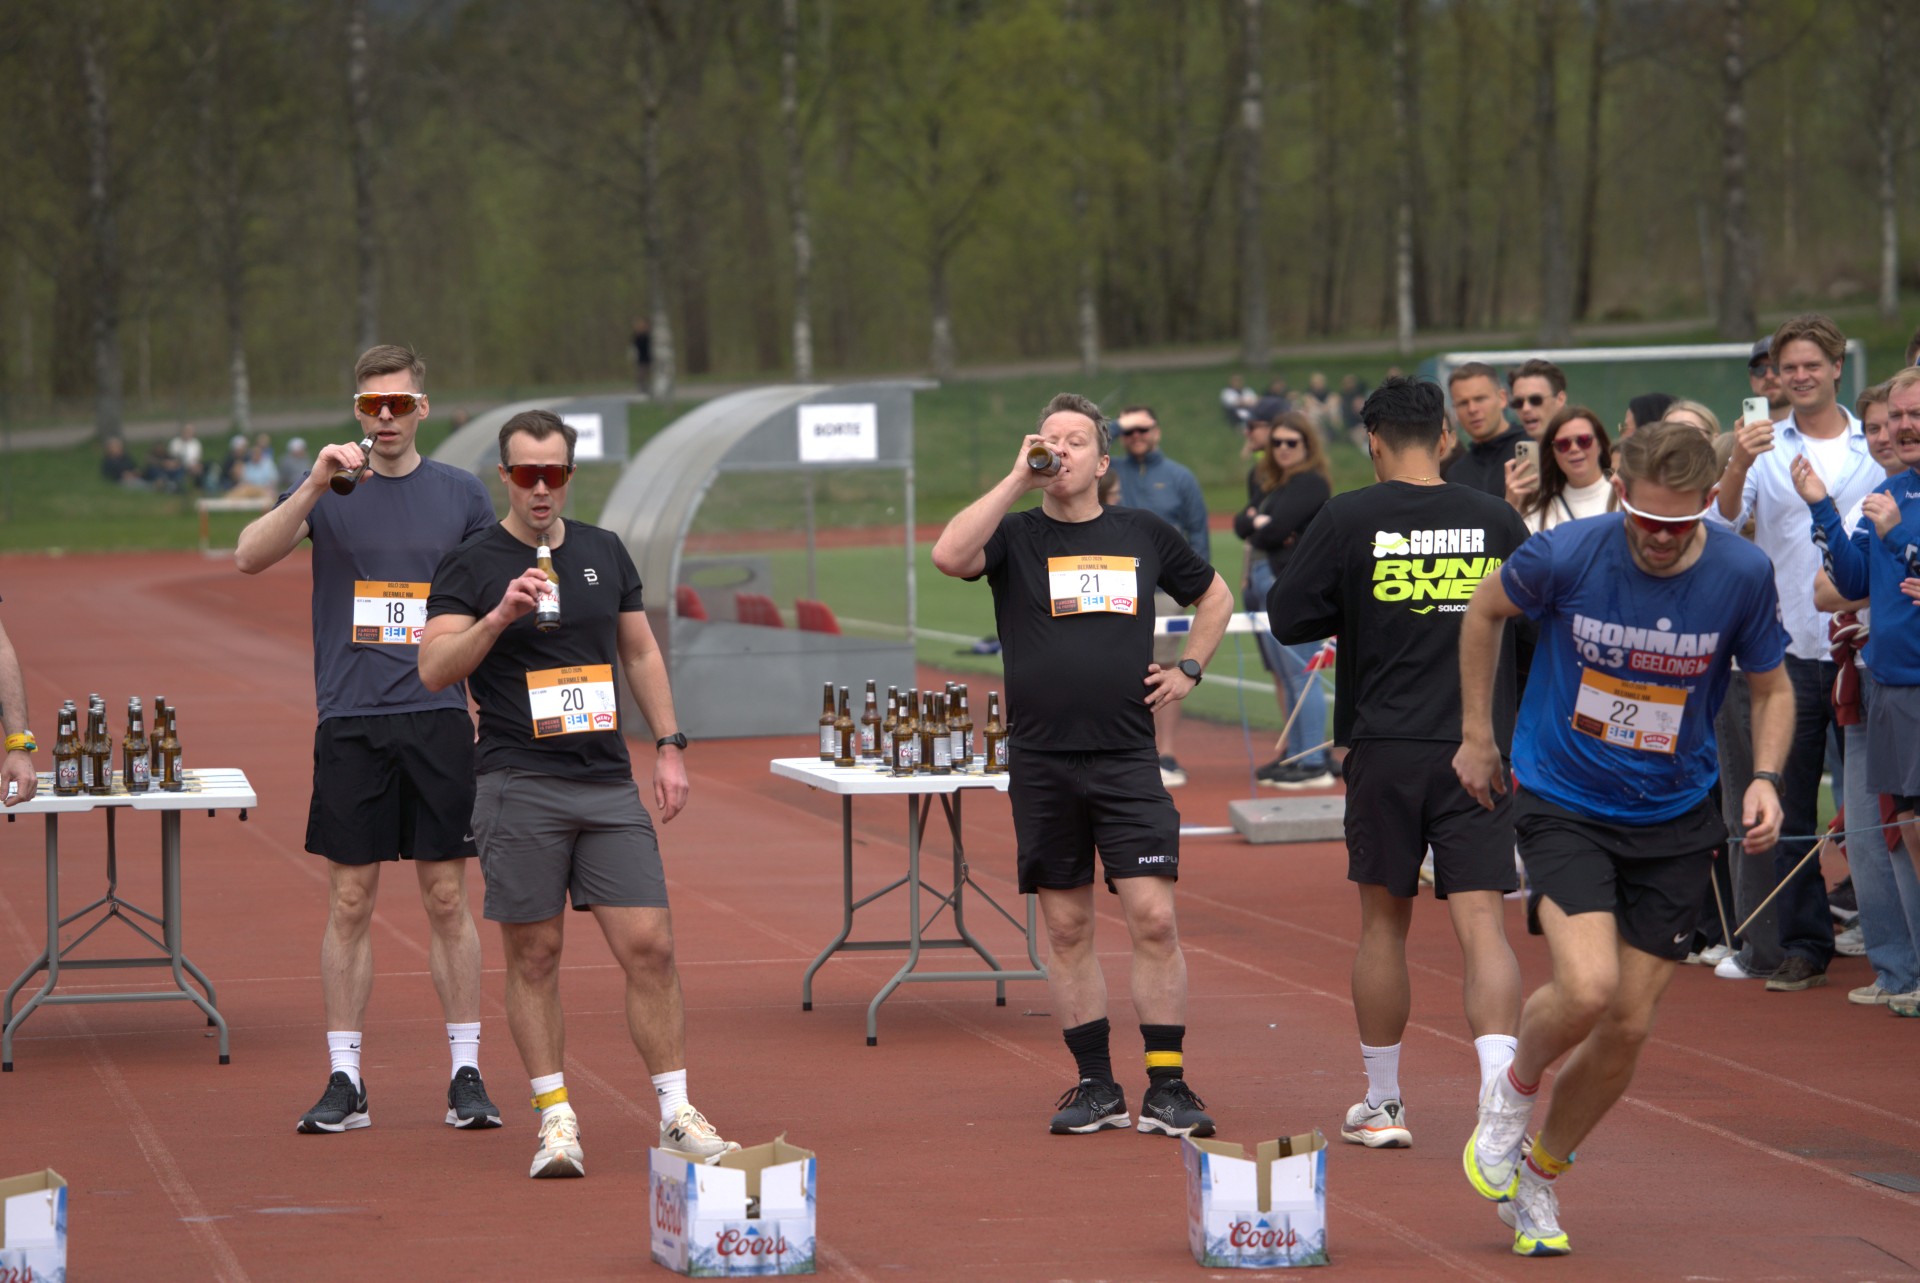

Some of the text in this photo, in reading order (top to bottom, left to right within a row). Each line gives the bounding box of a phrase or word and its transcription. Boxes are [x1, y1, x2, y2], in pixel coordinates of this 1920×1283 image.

[1410, 528, 1485, 555] CORNER
[1372, 557, 1486, 581] RUN
[1080, 573, 1100, 593] 21
[1373, 579, 1482, 601] ONE
[385, 602, 405, 624] 18
[1438, 604, 1469, 612] sauco
[1572, 613, 1719, 657] IRONMAN
[1631, 652, 1696, 675] GEELONG
[561, 687, 584, 712] 20
[1609, 700, 1639, 727] 22
[716, 1229, 788, 1257] Coors
[1228, 1221, 1296, 1248] Coors
